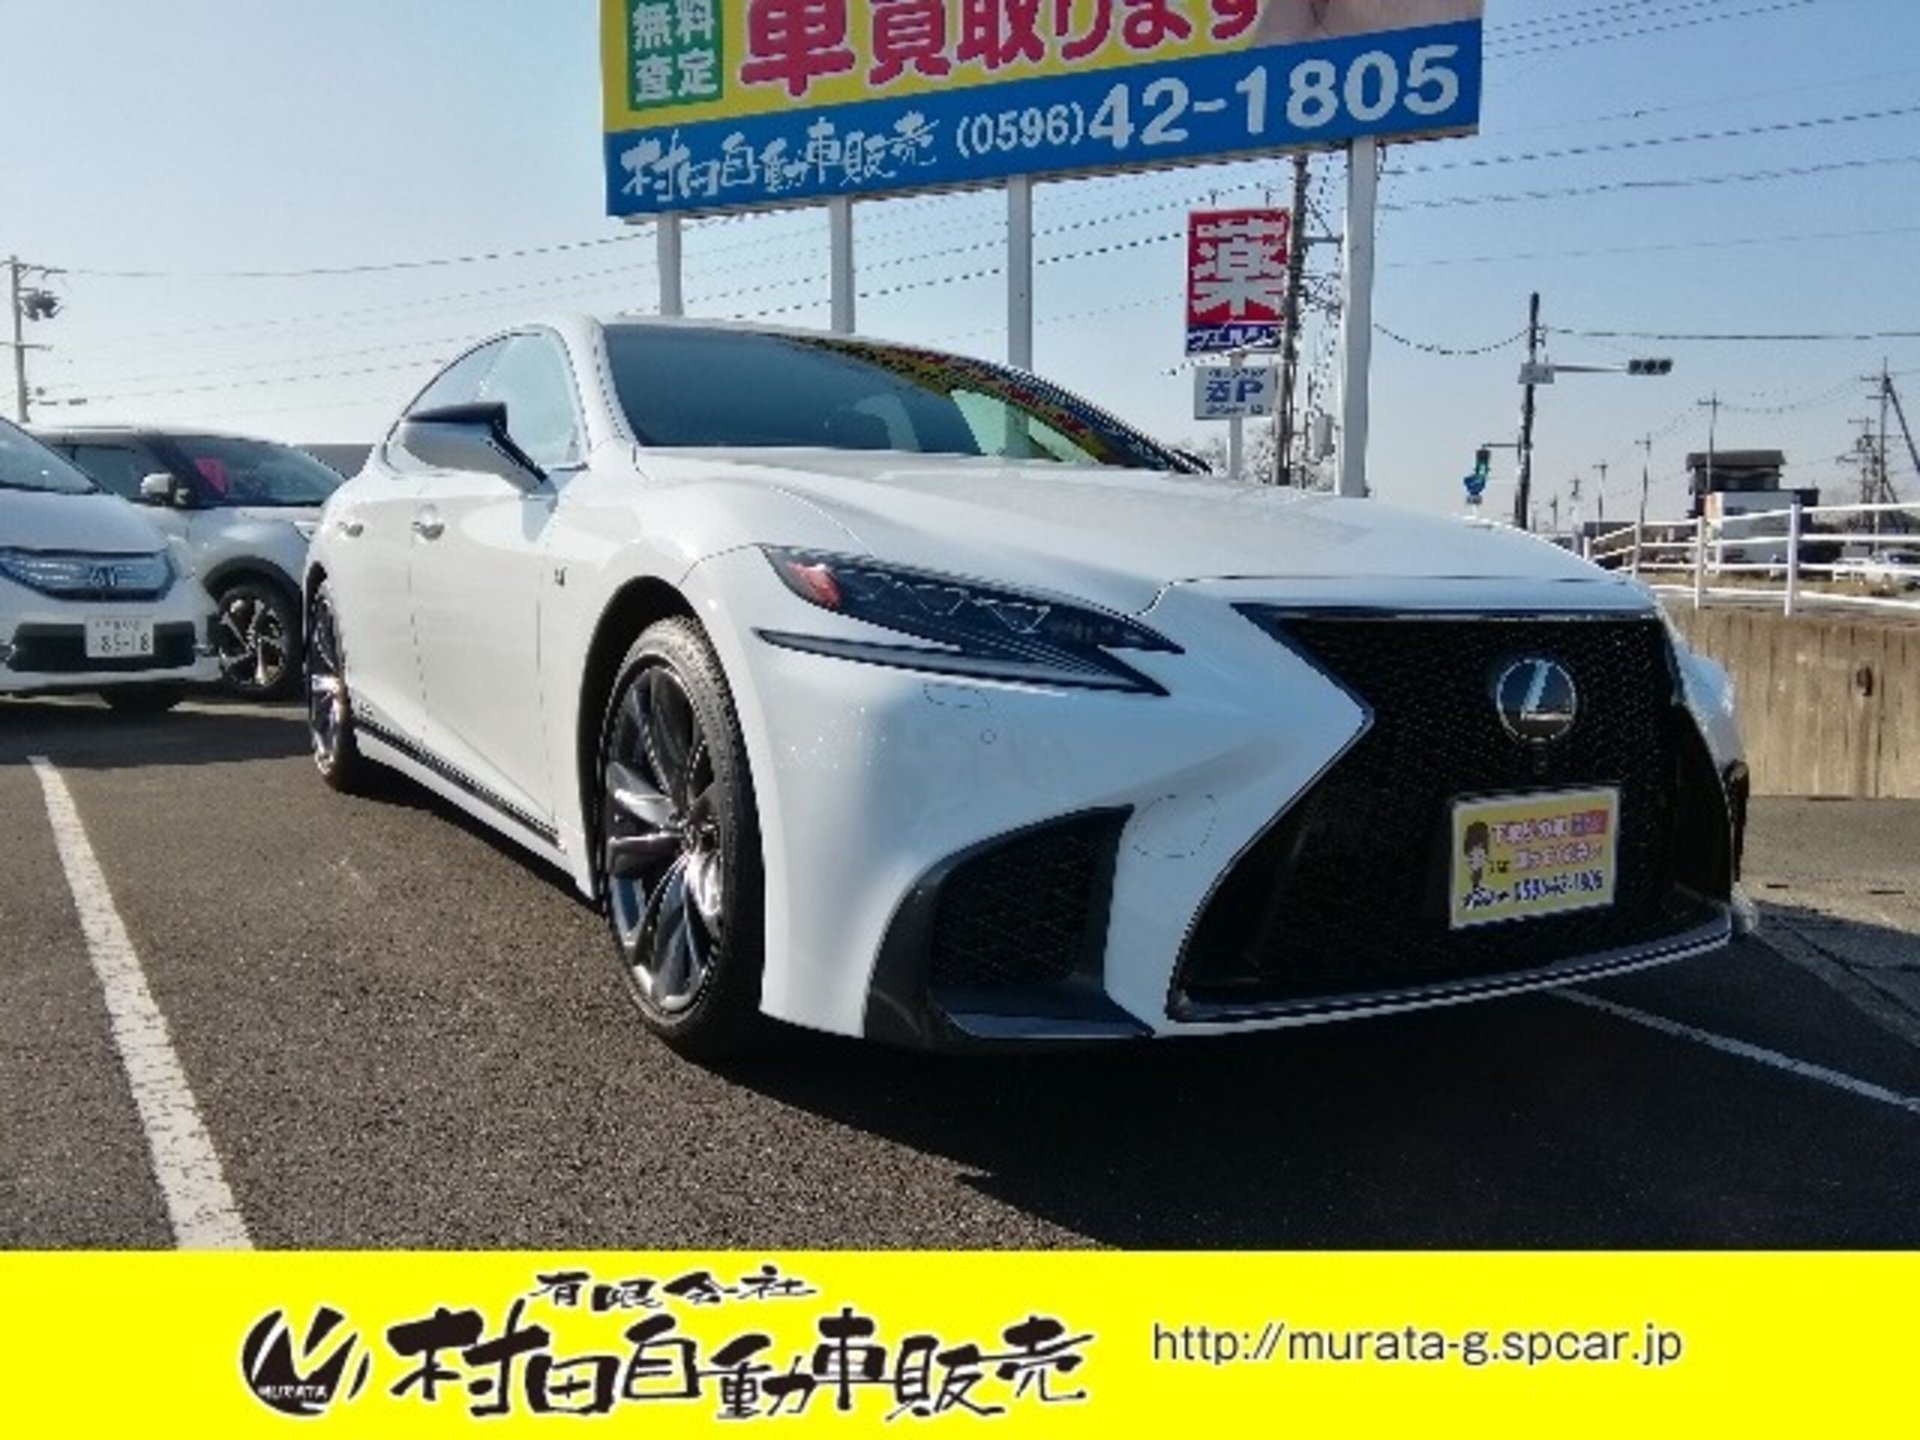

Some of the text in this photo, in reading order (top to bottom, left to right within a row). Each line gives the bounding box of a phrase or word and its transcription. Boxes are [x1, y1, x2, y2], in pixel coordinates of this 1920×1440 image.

[632, 0, 716, 51] 無料
[634, 48, 719, 102] 査定
[620, 110, 940, 203] 村田自動車販売
[1191, 217, 1286, 316] 薬
